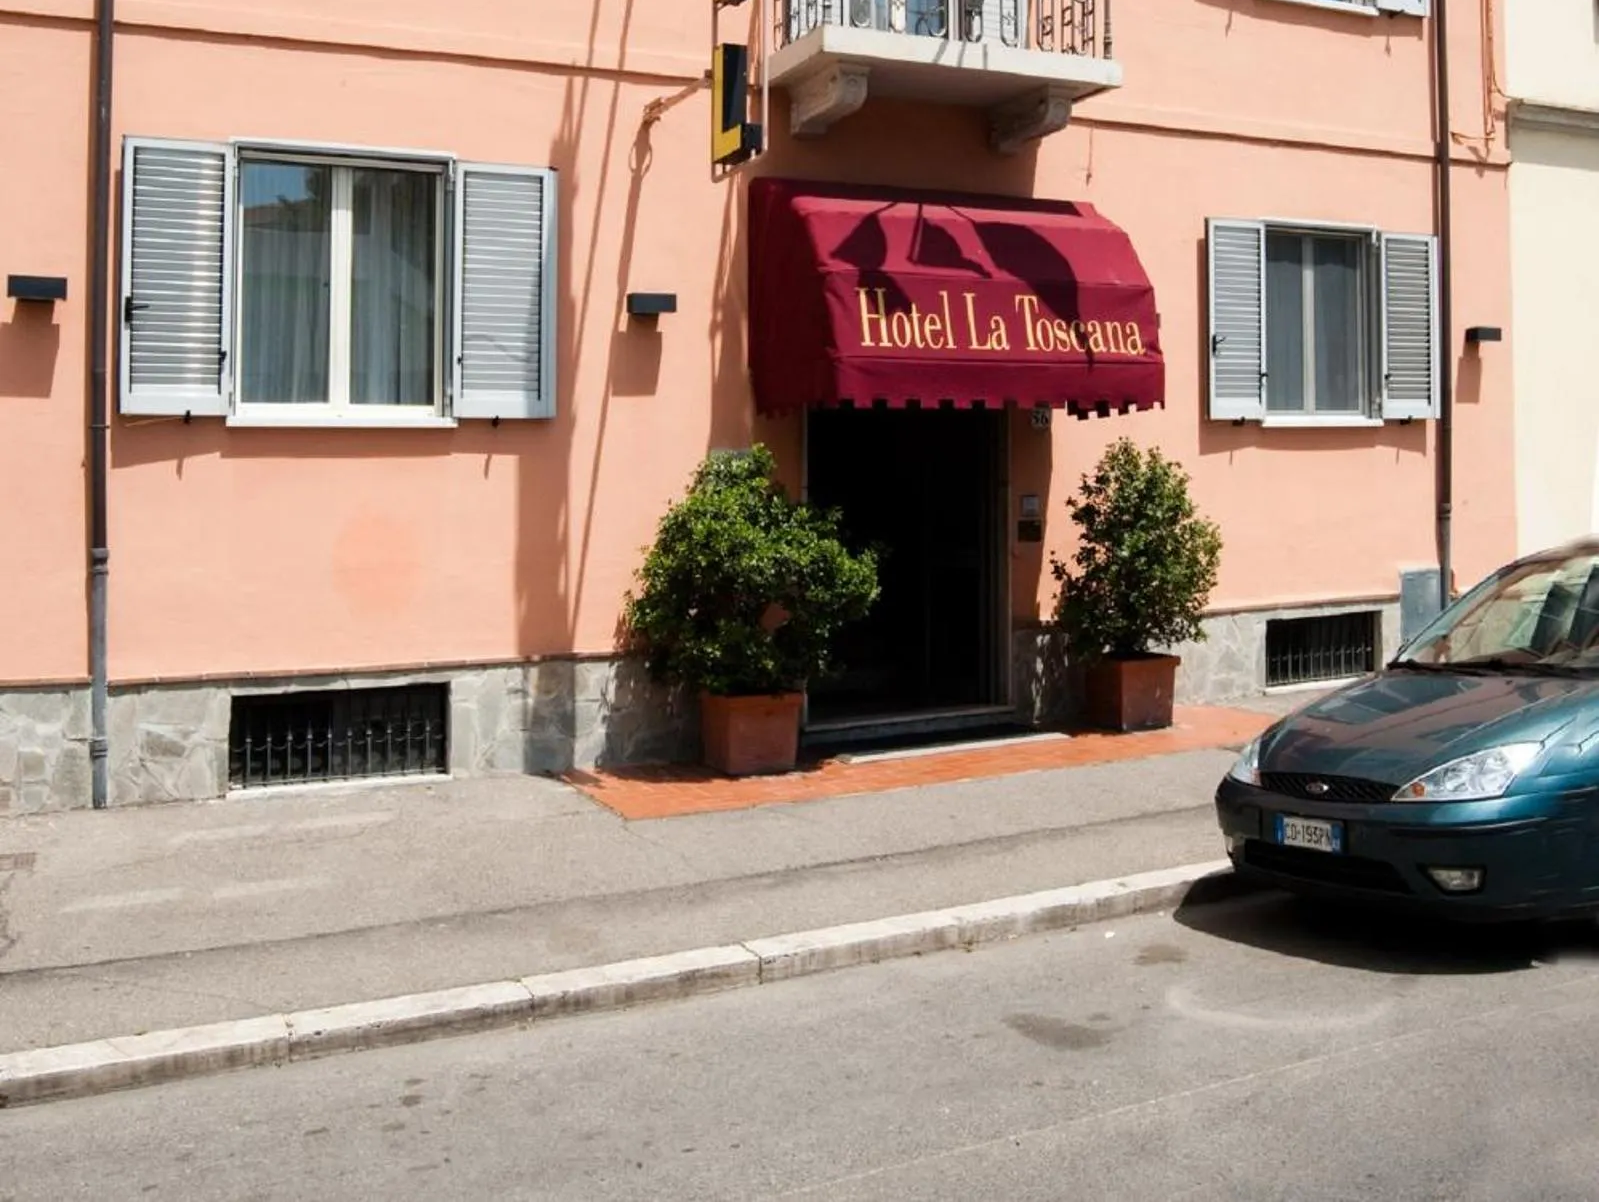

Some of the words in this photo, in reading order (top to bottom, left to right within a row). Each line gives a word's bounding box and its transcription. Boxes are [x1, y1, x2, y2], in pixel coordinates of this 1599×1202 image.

[855, 286, 957, 349] Hotel
[962, 291, 1010, 351] La
[1015, 294, 1146, 355] Toscana
